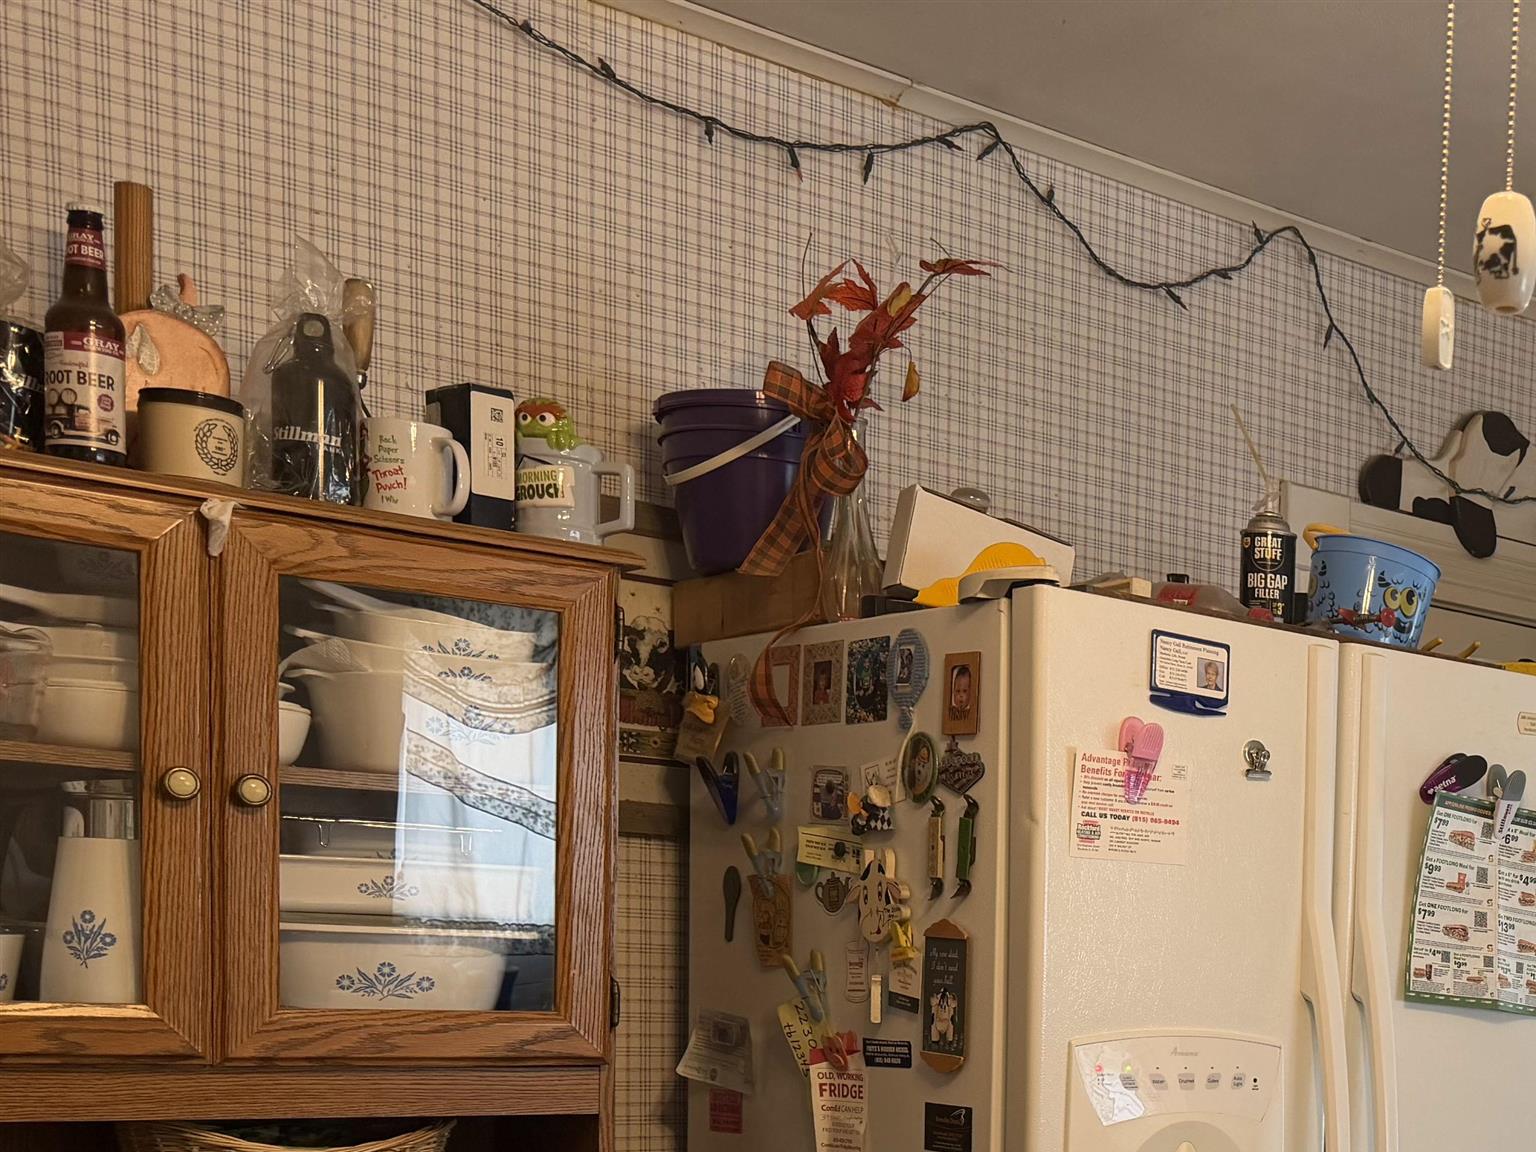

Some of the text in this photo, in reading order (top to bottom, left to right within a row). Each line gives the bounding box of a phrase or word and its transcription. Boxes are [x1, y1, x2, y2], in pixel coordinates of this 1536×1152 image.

[66, 244, 78, 255] OT
[77, 371, 115, 391] BEER
[273, 425, 343, 447] Stillman
[378, 444, 400, 455] Paper
[371, 465, 404, 481] Throat
[375, 478, 407, 493] Punch!
[1254, 536, 1282, 549] GREAT
[1254, 547, 1283, 561] STUFF
[1247, 573, 1288, 590] BIG GAP
[1254, 587, 1280, 600] FILLER
[1081, 753, 1121, 767] Advantage
[1080, 764, 1112, 775] Benefits
[1113, 768, 1126, 777] For
[1433, 775, 1457, 792] aetna
[817, 1071, 864, 1082] OLD, WORKING
[818, 1082, 864, 1100] FRIDGE
